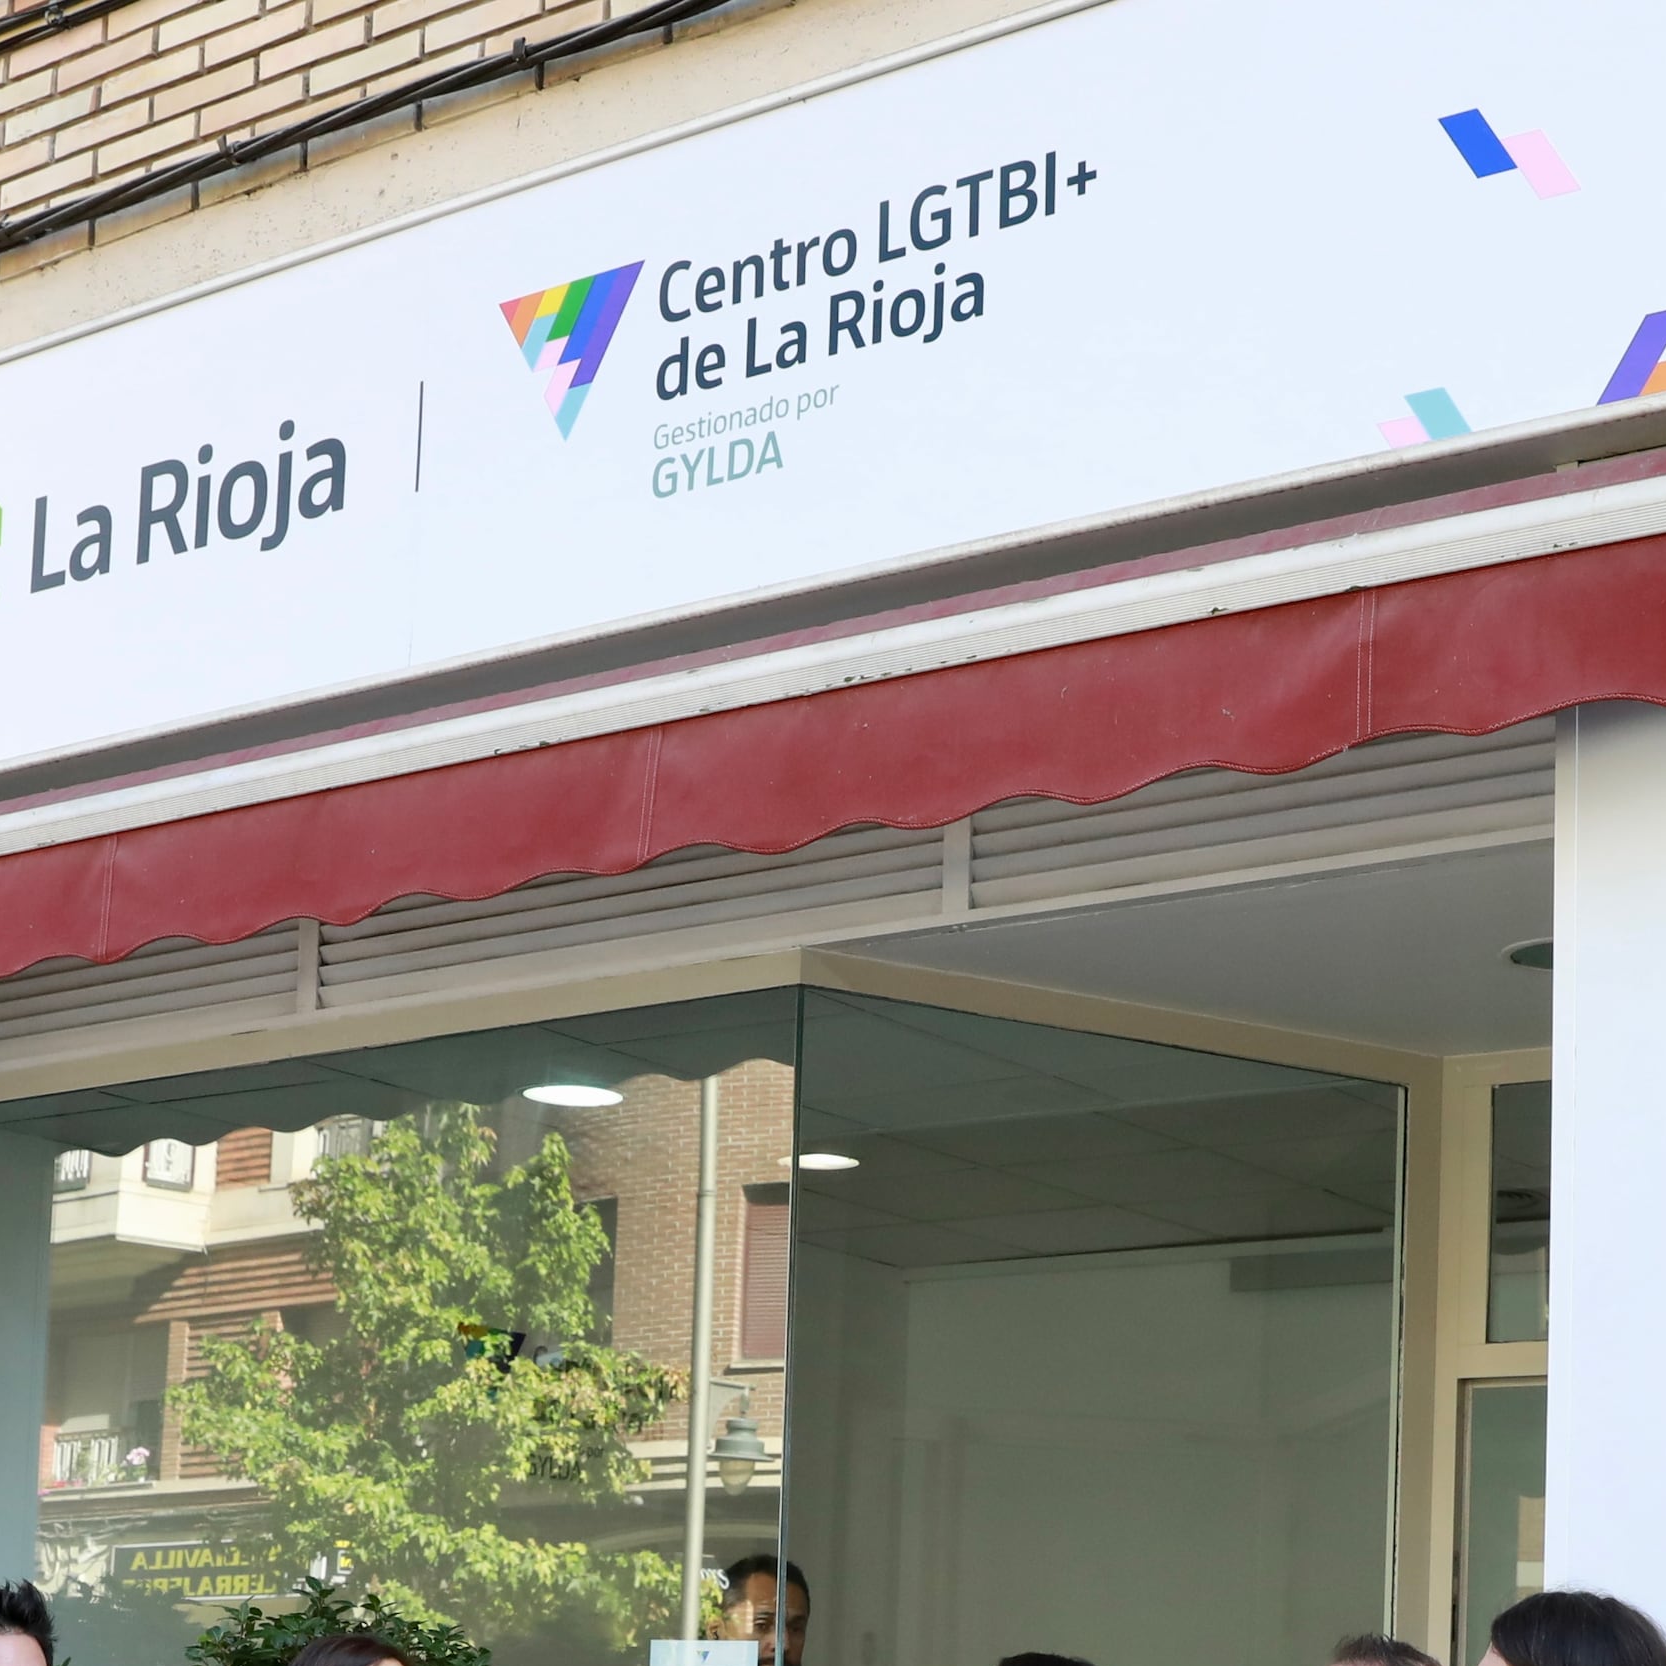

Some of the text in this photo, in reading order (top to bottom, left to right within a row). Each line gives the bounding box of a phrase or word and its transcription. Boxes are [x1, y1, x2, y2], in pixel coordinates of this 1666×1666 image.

[658, 151, 1097, 323] Centro LGTBI+
[656, 262, 985, 401] de La Rioja
[652, 431, 784, 498] GYLDA
[654, 384, 840, 450] Gestionado por
[30, 419, 347, 594] La Rioja
